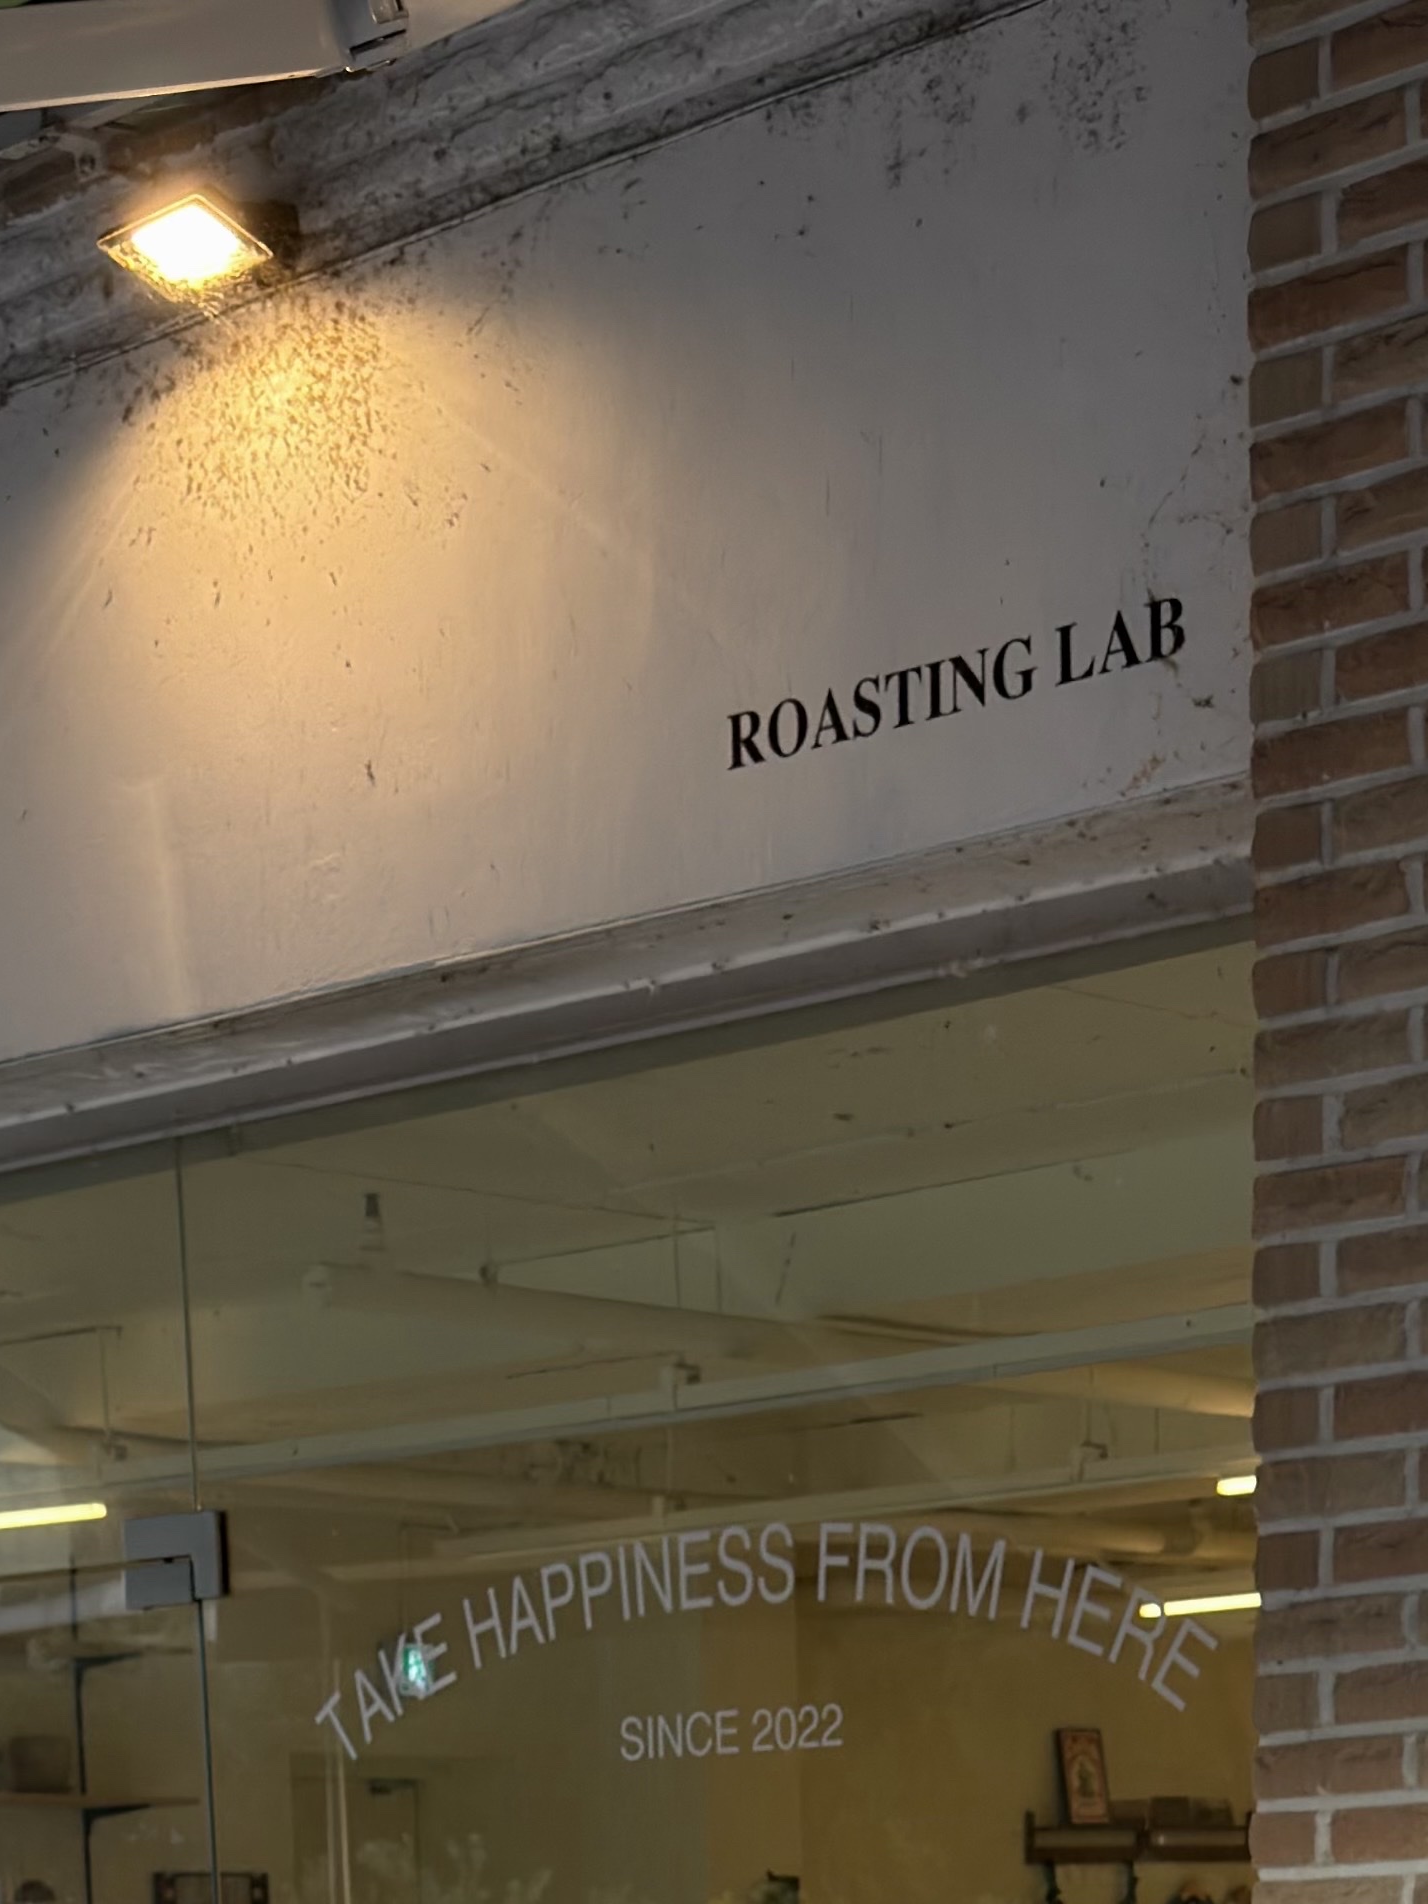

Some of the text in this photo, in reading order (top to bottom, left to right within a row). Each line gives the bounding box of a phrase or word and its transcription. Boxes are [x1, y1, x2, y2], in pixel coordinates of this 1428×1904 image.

[727, 596, 1186, 770] ROASTING LAB
[314, 1522, 1218, 1761] TAKE HAPPINESS FROM HERE
[619, 1704, 844, 1762] SINCE 2022
